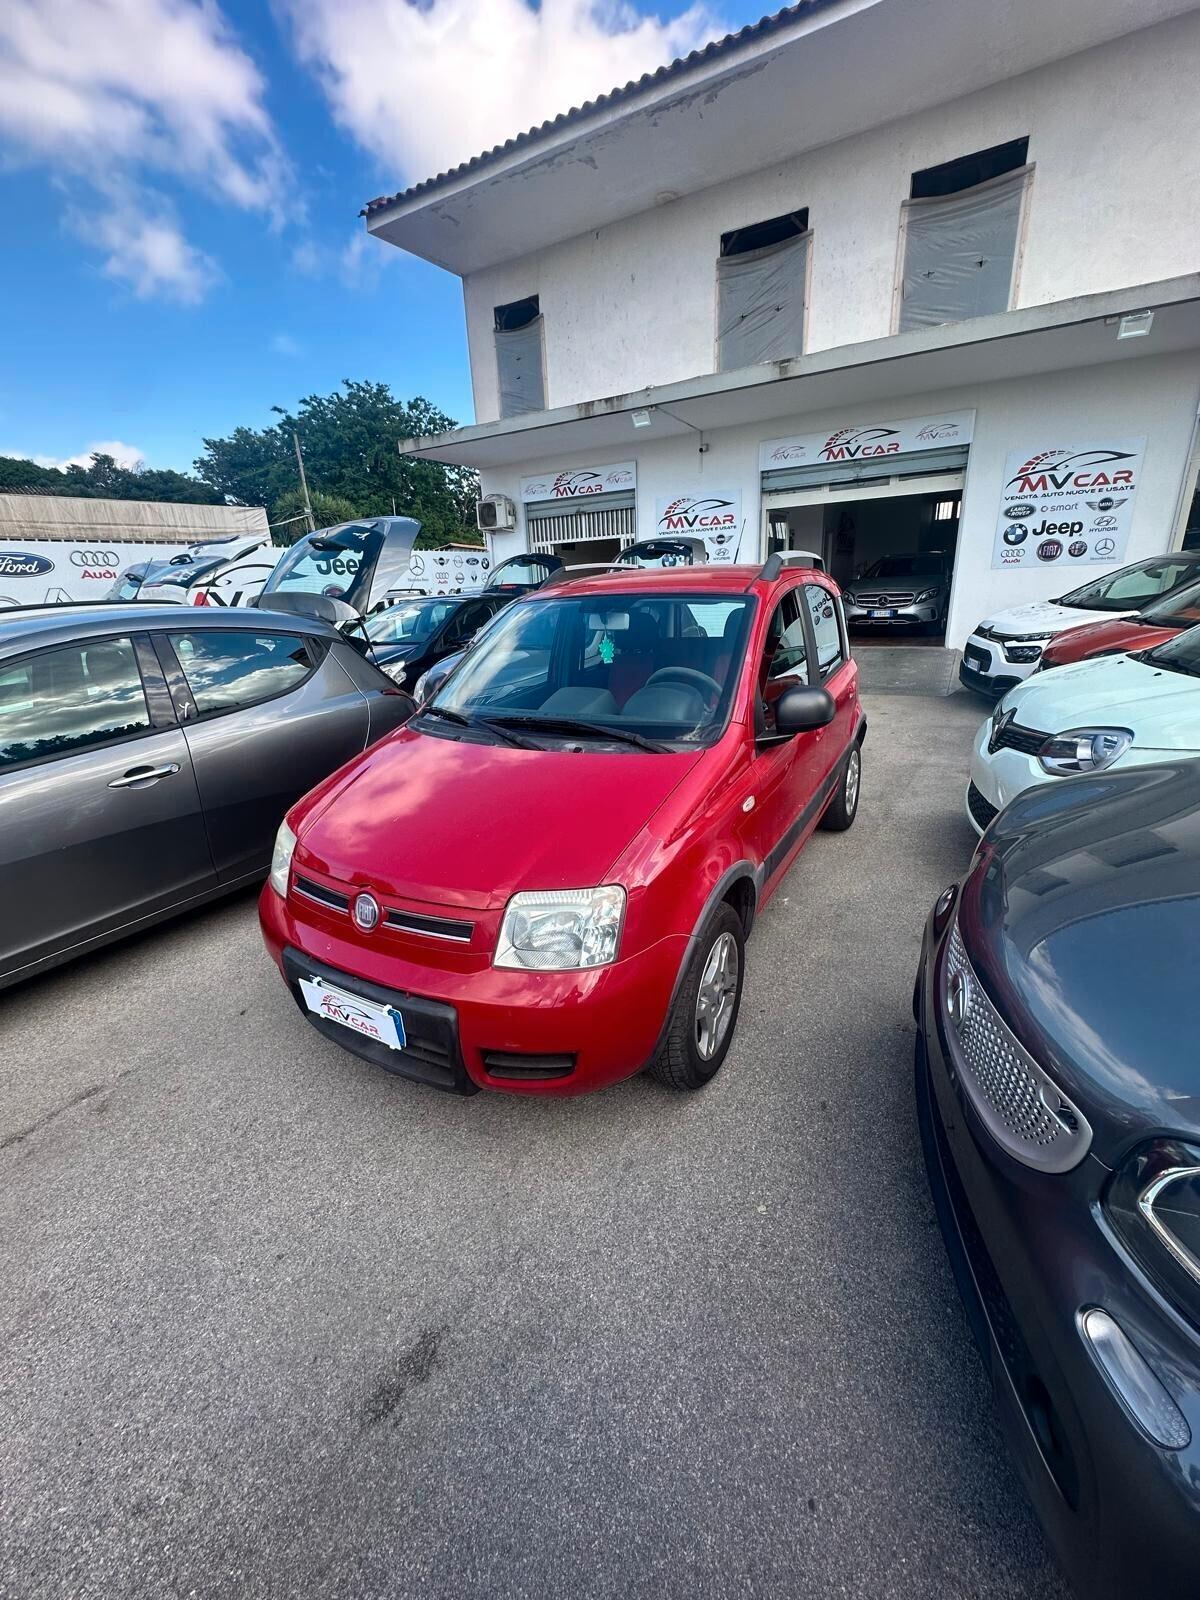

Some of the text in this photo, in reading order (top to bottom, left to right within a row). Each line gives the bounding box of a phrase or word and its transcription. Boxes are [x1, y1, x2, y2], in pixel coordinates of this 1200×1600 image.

[825, 442, 900, 461] MVCAR
[1018, 470, 1133, 493] MVCAR
[555, 484, 603, 497] MVCAR
[1004, 493, 1038, 501] VENDITA
[1066, 488, 1095, 496] NUOVE
[1050, 503, 1079, 512] smart
[666, 514, 735, 530] MVCAR
[1032, 520, 1084, 537] Jeep
[1042, 544, 1058, 556] FIAT
[81, 569, 117, 579] Audi
[315, 558, 359, 576] Jee
[327, 1005, 379, 1035] MVCAR
